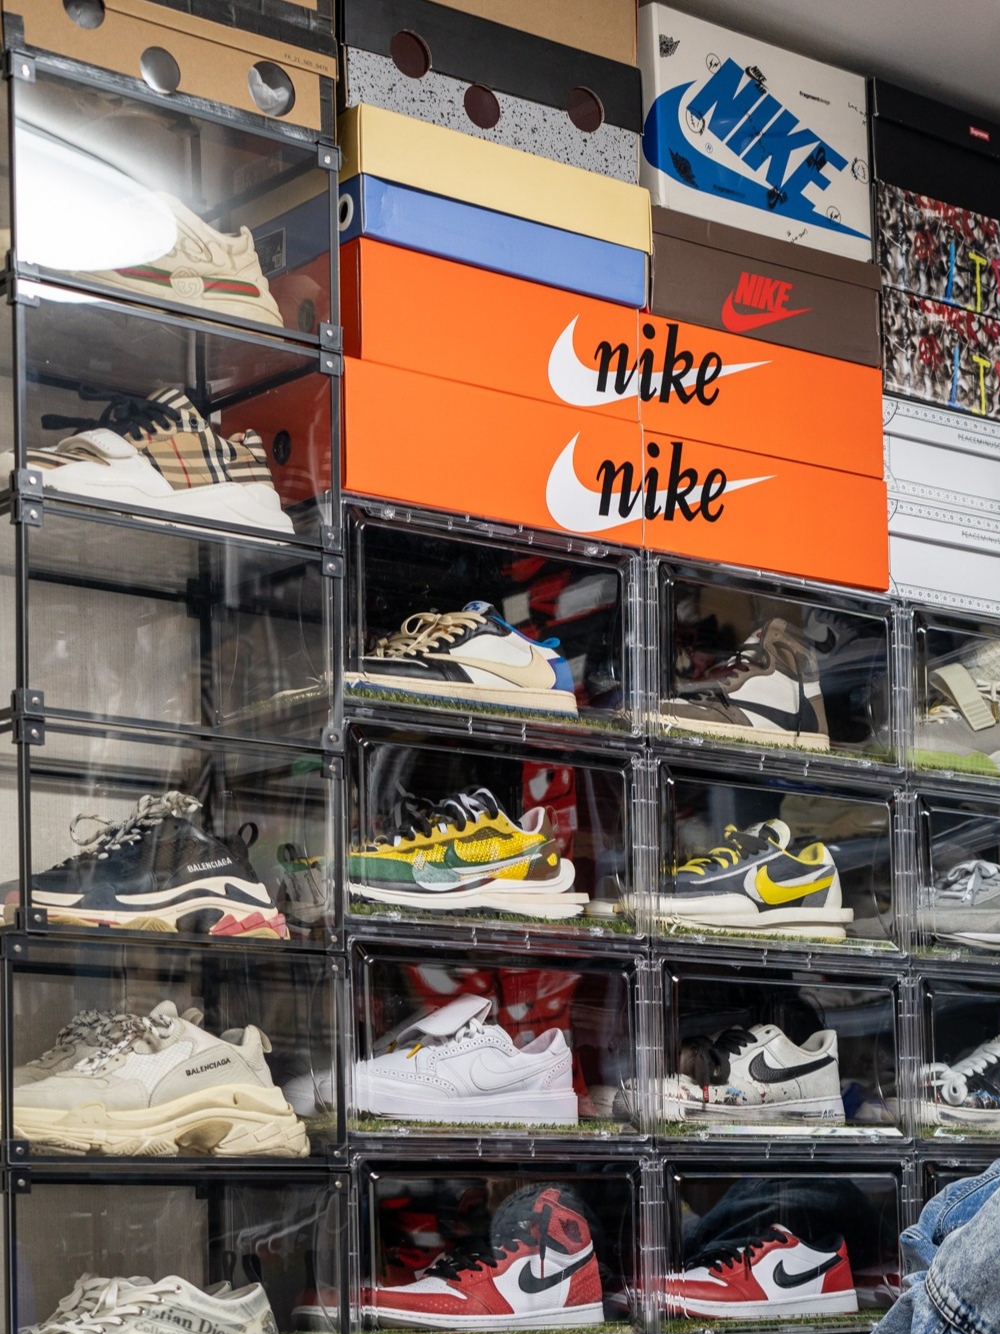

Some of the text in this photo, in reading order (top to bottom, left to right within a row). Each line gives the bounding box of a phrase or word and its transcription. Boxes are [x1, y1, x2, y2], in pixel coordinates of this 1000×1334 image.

[686, 57, 849, 211] NIKE
[733, 271, 793, 313] NIKE
[594, 323, 723, 406] nike
[596, 441, 727, 523] nike
[187, 856, 233, 873] BALENCIAGA
[185, 1057, 231, 1076] BALENCIAGA
